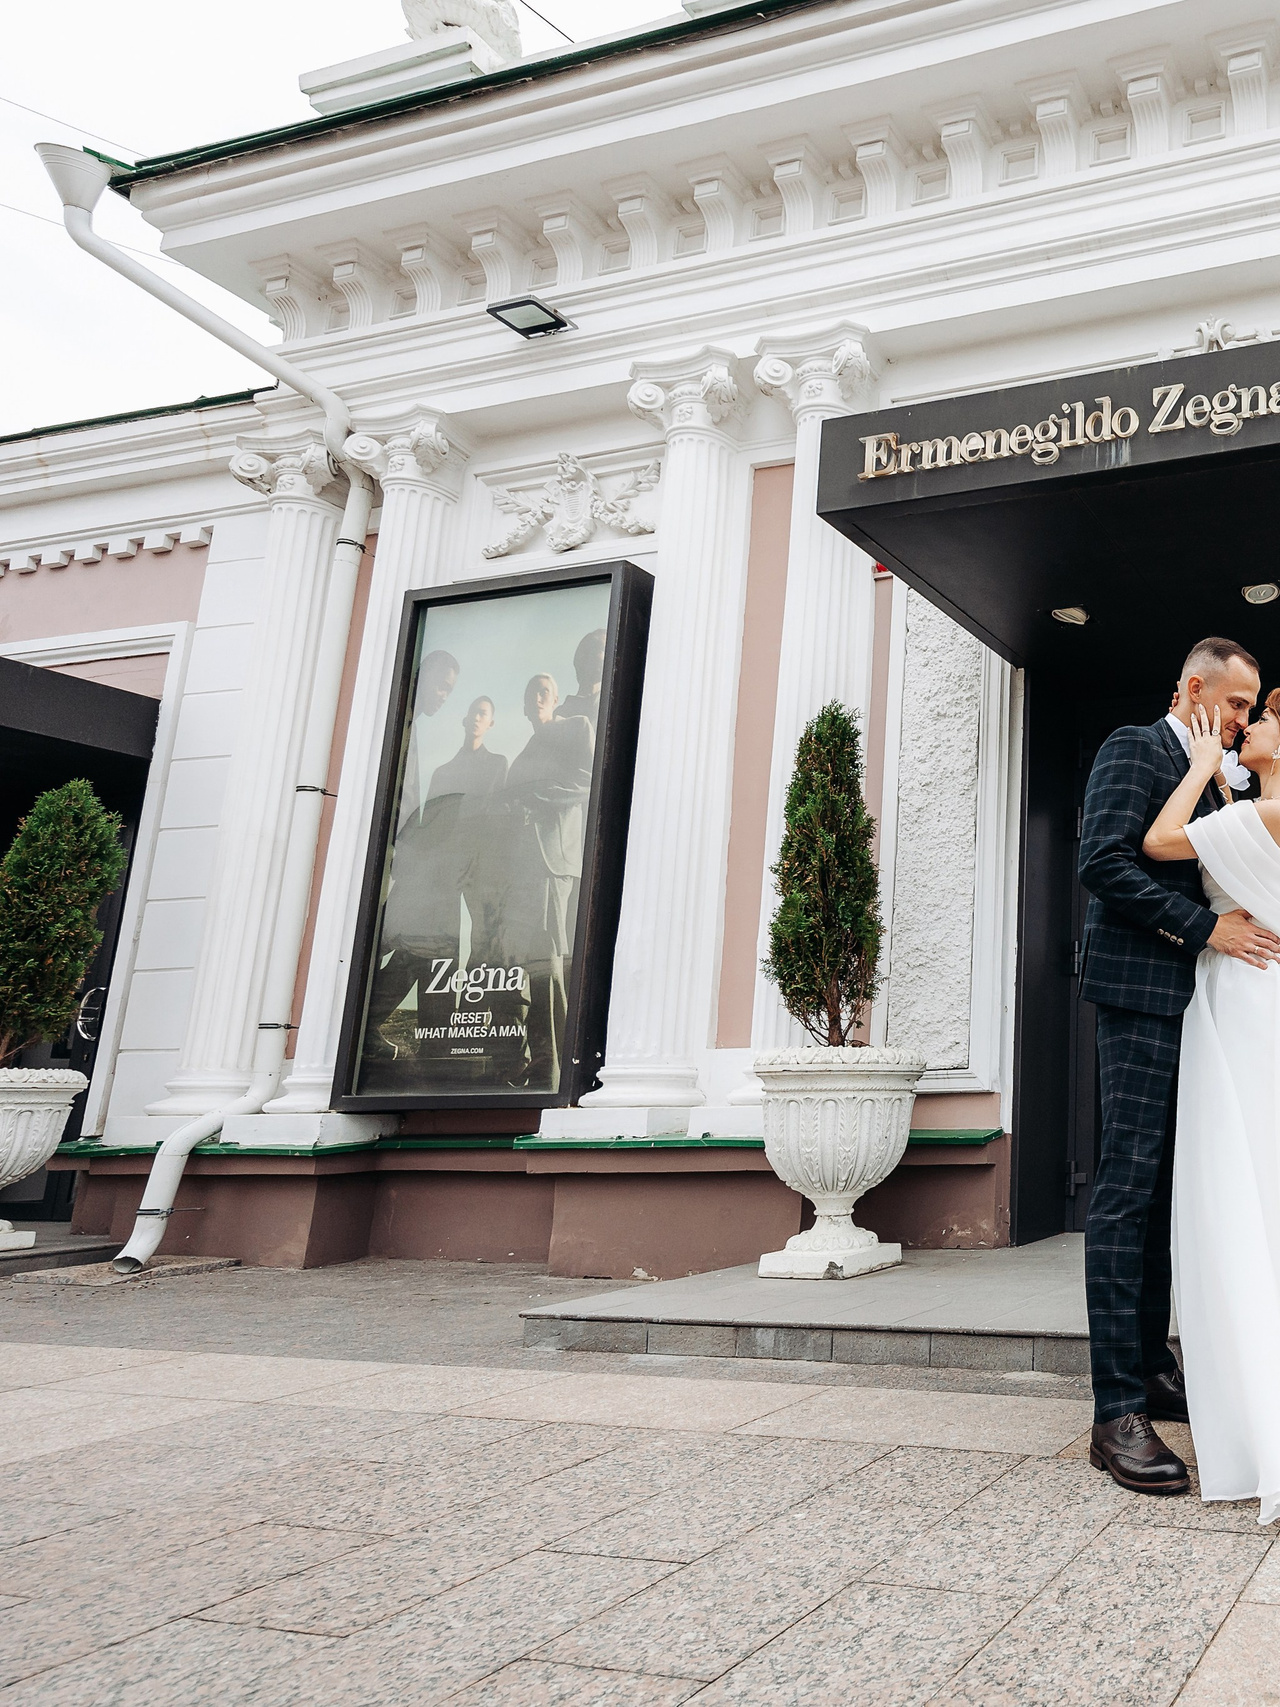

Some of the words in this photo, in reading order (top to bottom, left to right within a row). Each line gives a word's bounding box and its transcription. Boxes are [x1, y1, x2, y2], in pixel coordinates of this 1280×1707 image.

[857, 396, 1139, 480] Ermenegildo
[425, 959, 526, 1003] Zegna
[414, 1027, 446, 1039] WHAT
[448, 1027, 487, 1038] MAKES
[489, 1027, 497, 1037] A
[499, 1026, 526, 1037] MAN
[450, 1011, 492, 1025] (RESET)
